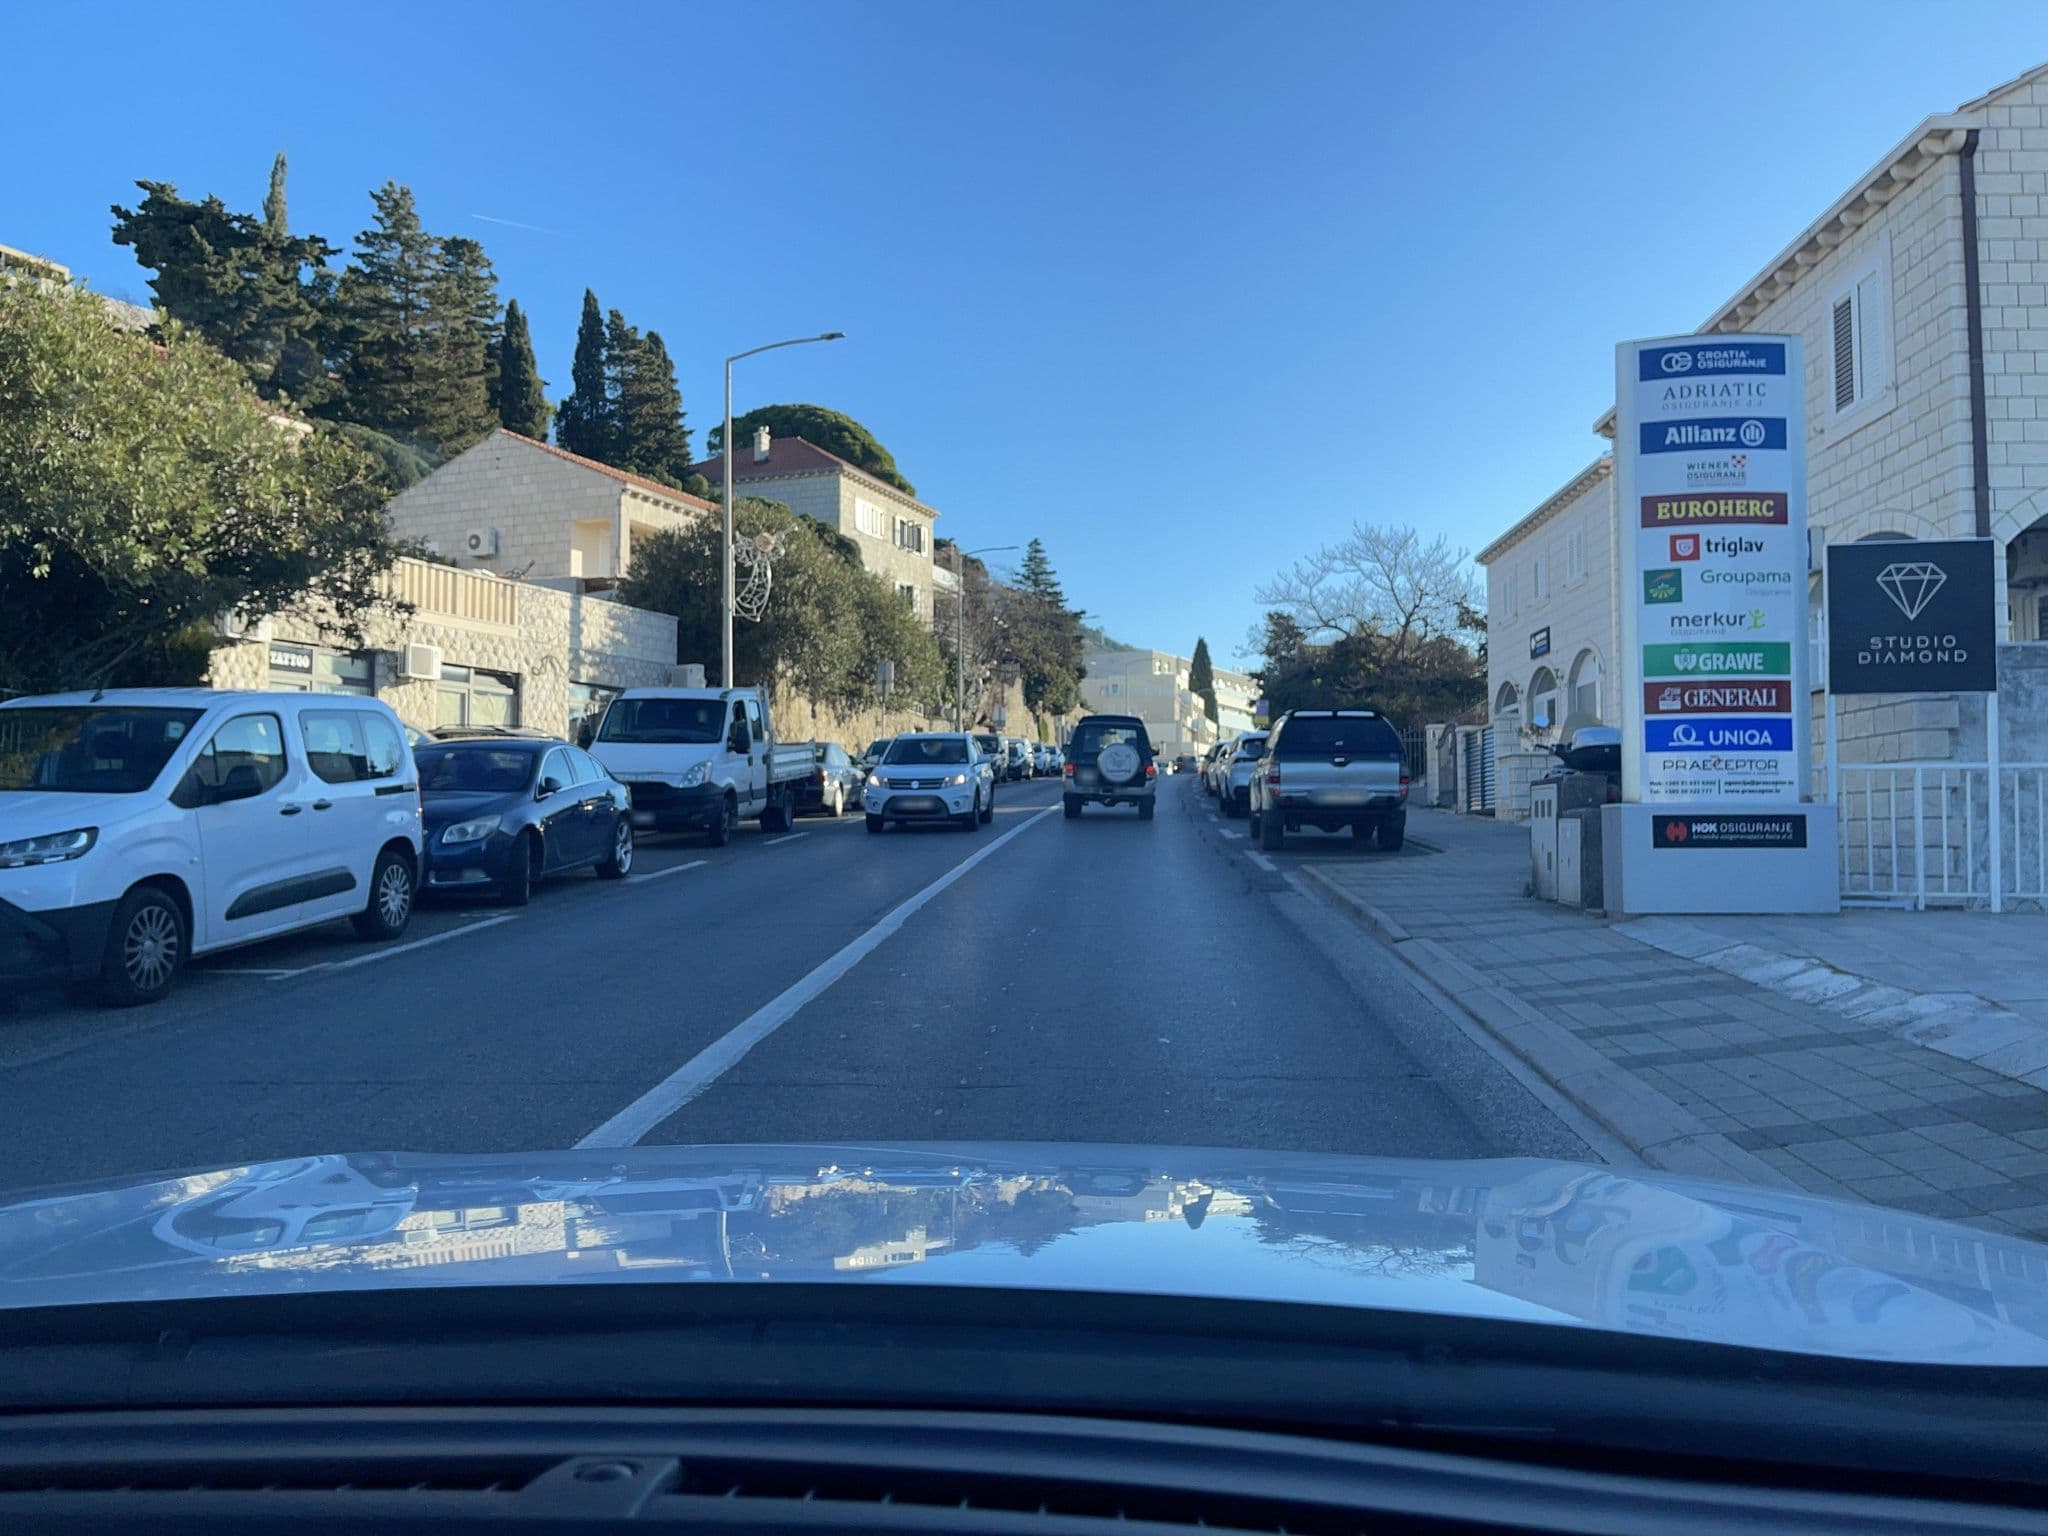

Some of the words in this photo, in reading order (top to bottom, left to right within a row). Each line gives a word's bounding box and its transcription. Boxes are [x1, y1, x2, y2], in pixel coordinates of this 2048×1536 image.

[1697, 350, 1747, 360] CROATIA
[1697, 358, 1767, 369] OSIGURANJE
[1663, 382, 1767, 401] ADRIATIC
[1664, 425, 1737, 446] Allianz
[1687, 461, 1729, 471] WIENER
[1657, 499, 1775, 521] EUROHERC
[1705, 537, 1764, 558] triglav
[1700, 569, 1791, 586] Groupama
[1670, 611, 1746, 628] merkur
[1870, 635, 1957, 650] STUDIO
[1700, 652, 1764, 671] GRAWE
[1858, 650, 1968, 665] DIAMOND
[1684, 687, 1777, 707] GENERALI
[1709, 730, 1773, 746] UNIQA
[1663, 759, 1778, 771] PRAECEPTOR
[1720, 822, 1793, 833] OSIGURANJE
